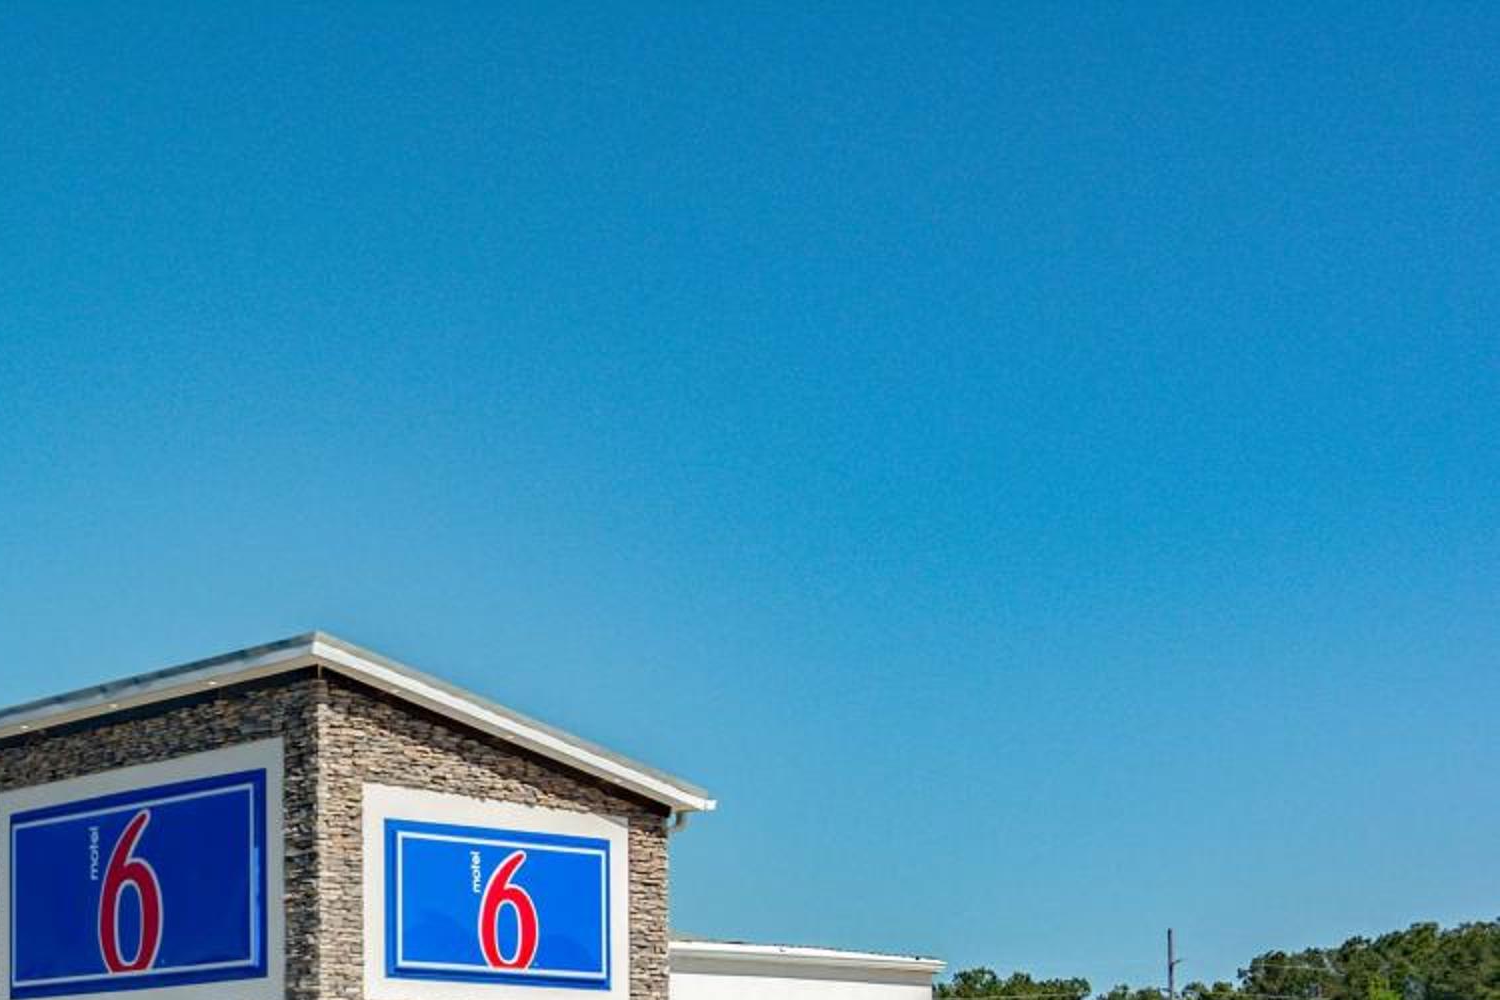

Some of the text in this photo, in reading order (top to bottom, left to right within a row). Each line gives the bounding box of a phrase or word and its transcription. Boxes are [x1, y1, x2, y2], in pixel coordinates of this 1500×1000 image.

[87, 809, 164, 976] motel 6
[469, 850, 539, 970] motel 6
